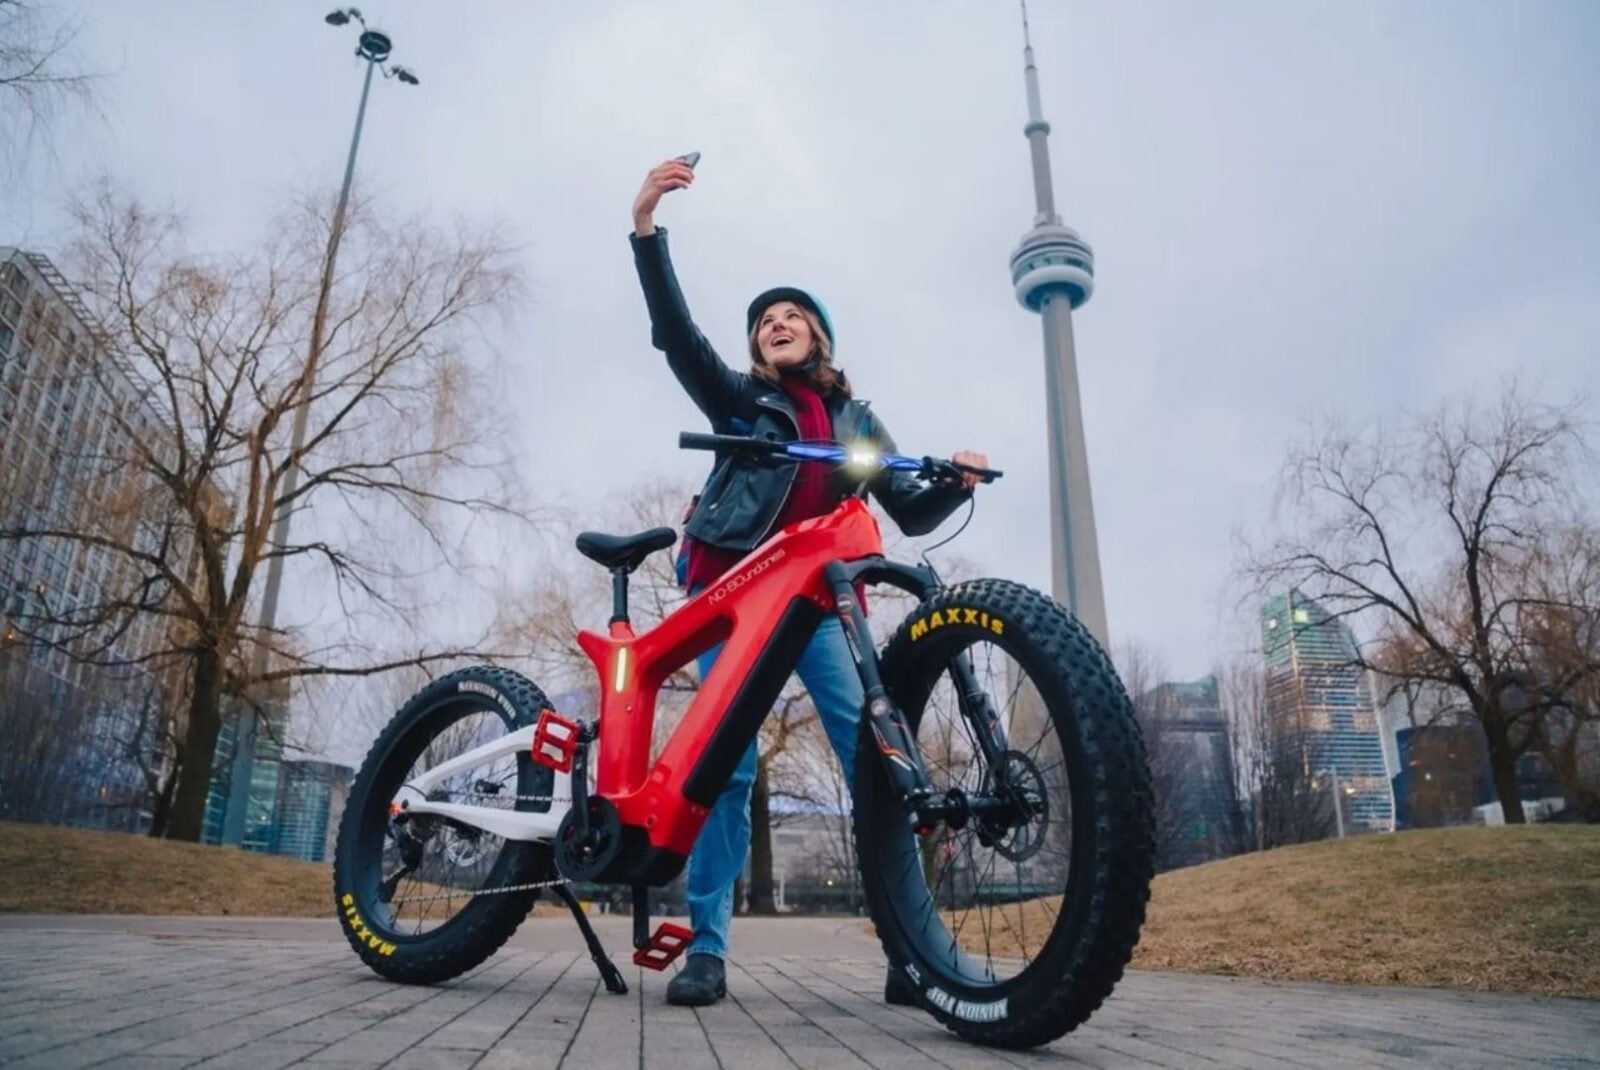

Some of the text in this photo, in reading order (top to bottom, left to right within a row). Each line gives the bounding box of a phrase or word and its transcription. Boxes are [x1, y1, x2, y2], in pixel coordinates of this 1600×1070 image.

[911, 608, 1004, 641] MAXXIS
[342, 894, 397, 956] MAXXIS
[955, 998, 1008, 1022] MINION
